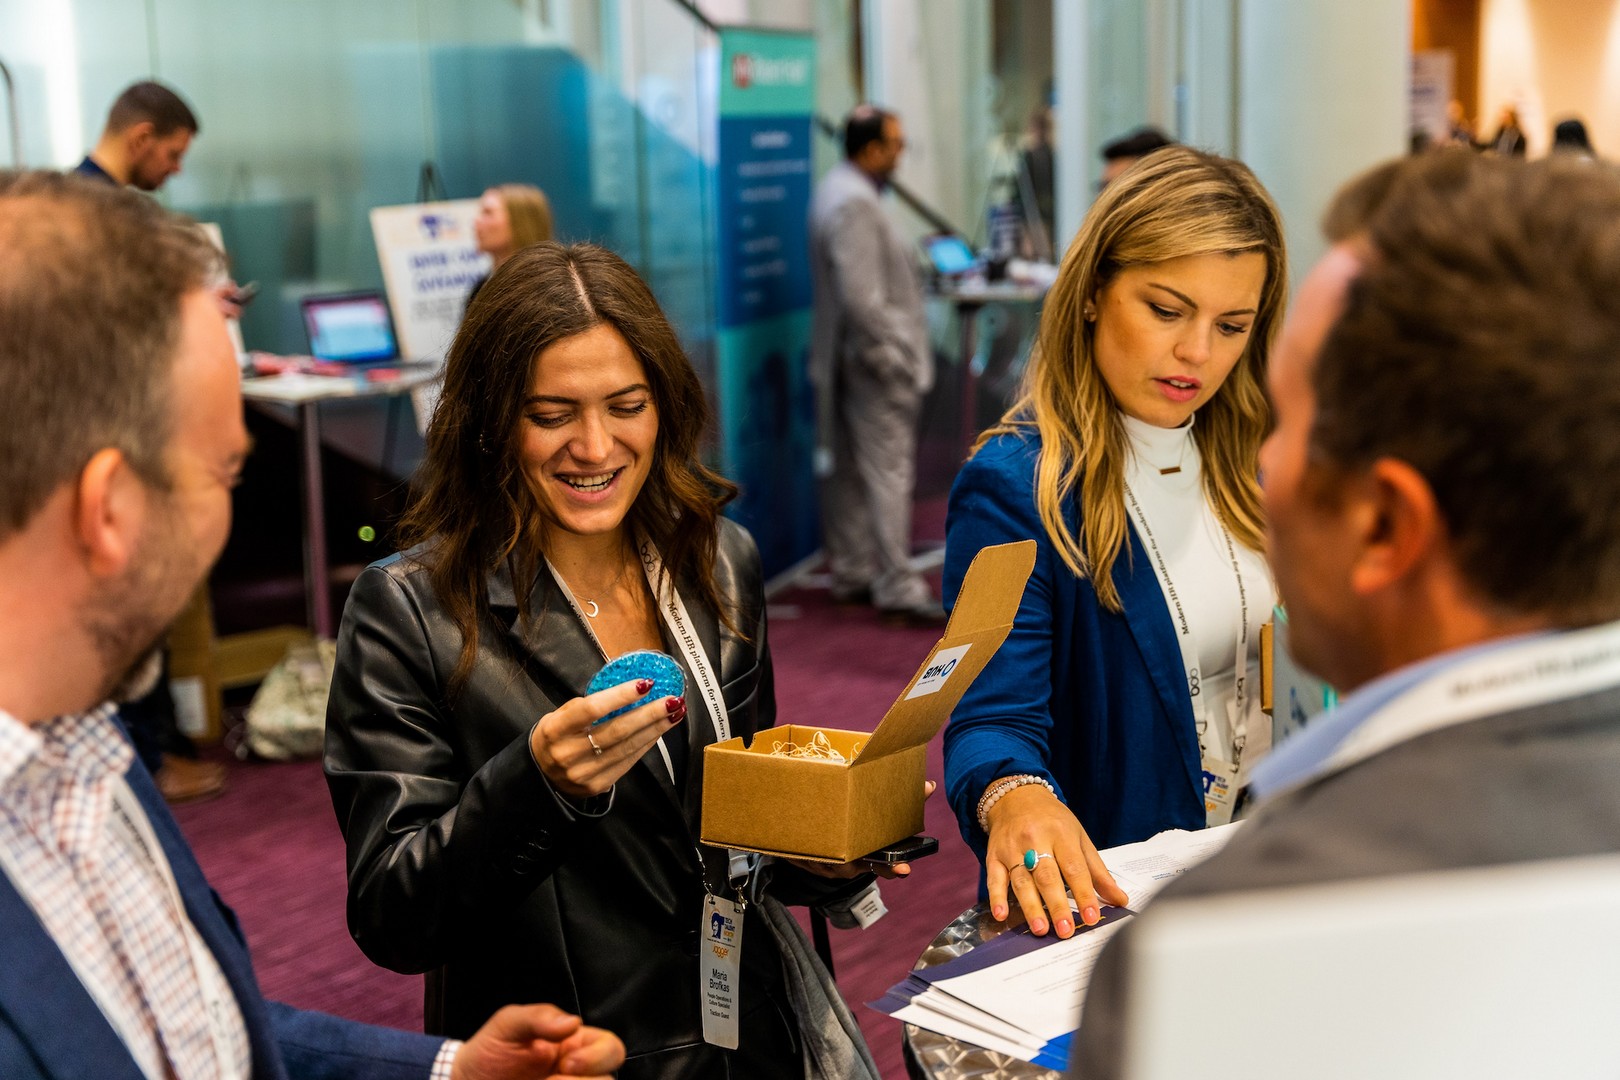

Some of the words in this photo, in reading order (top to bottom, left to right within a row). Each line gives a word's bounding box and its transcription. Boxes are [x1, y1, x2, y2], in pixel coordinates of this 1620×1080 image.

[1135, 506, 1152, 537] modern
[1155, 551, 1172, 586] platform
[1168, 586, 1178, 601] HR
[1175, 601, 1189, 635] Modern
[667, 601, 686, 636] Modern
[684, 635, 696, 651] HR
[690, 650, 711, 688] platform
[707, 688, 716, 702] for
[712, 703, 726, 738] modern
[709, 978, 730, 992] Brofkas
[712, 968, 727, 981] Maria
